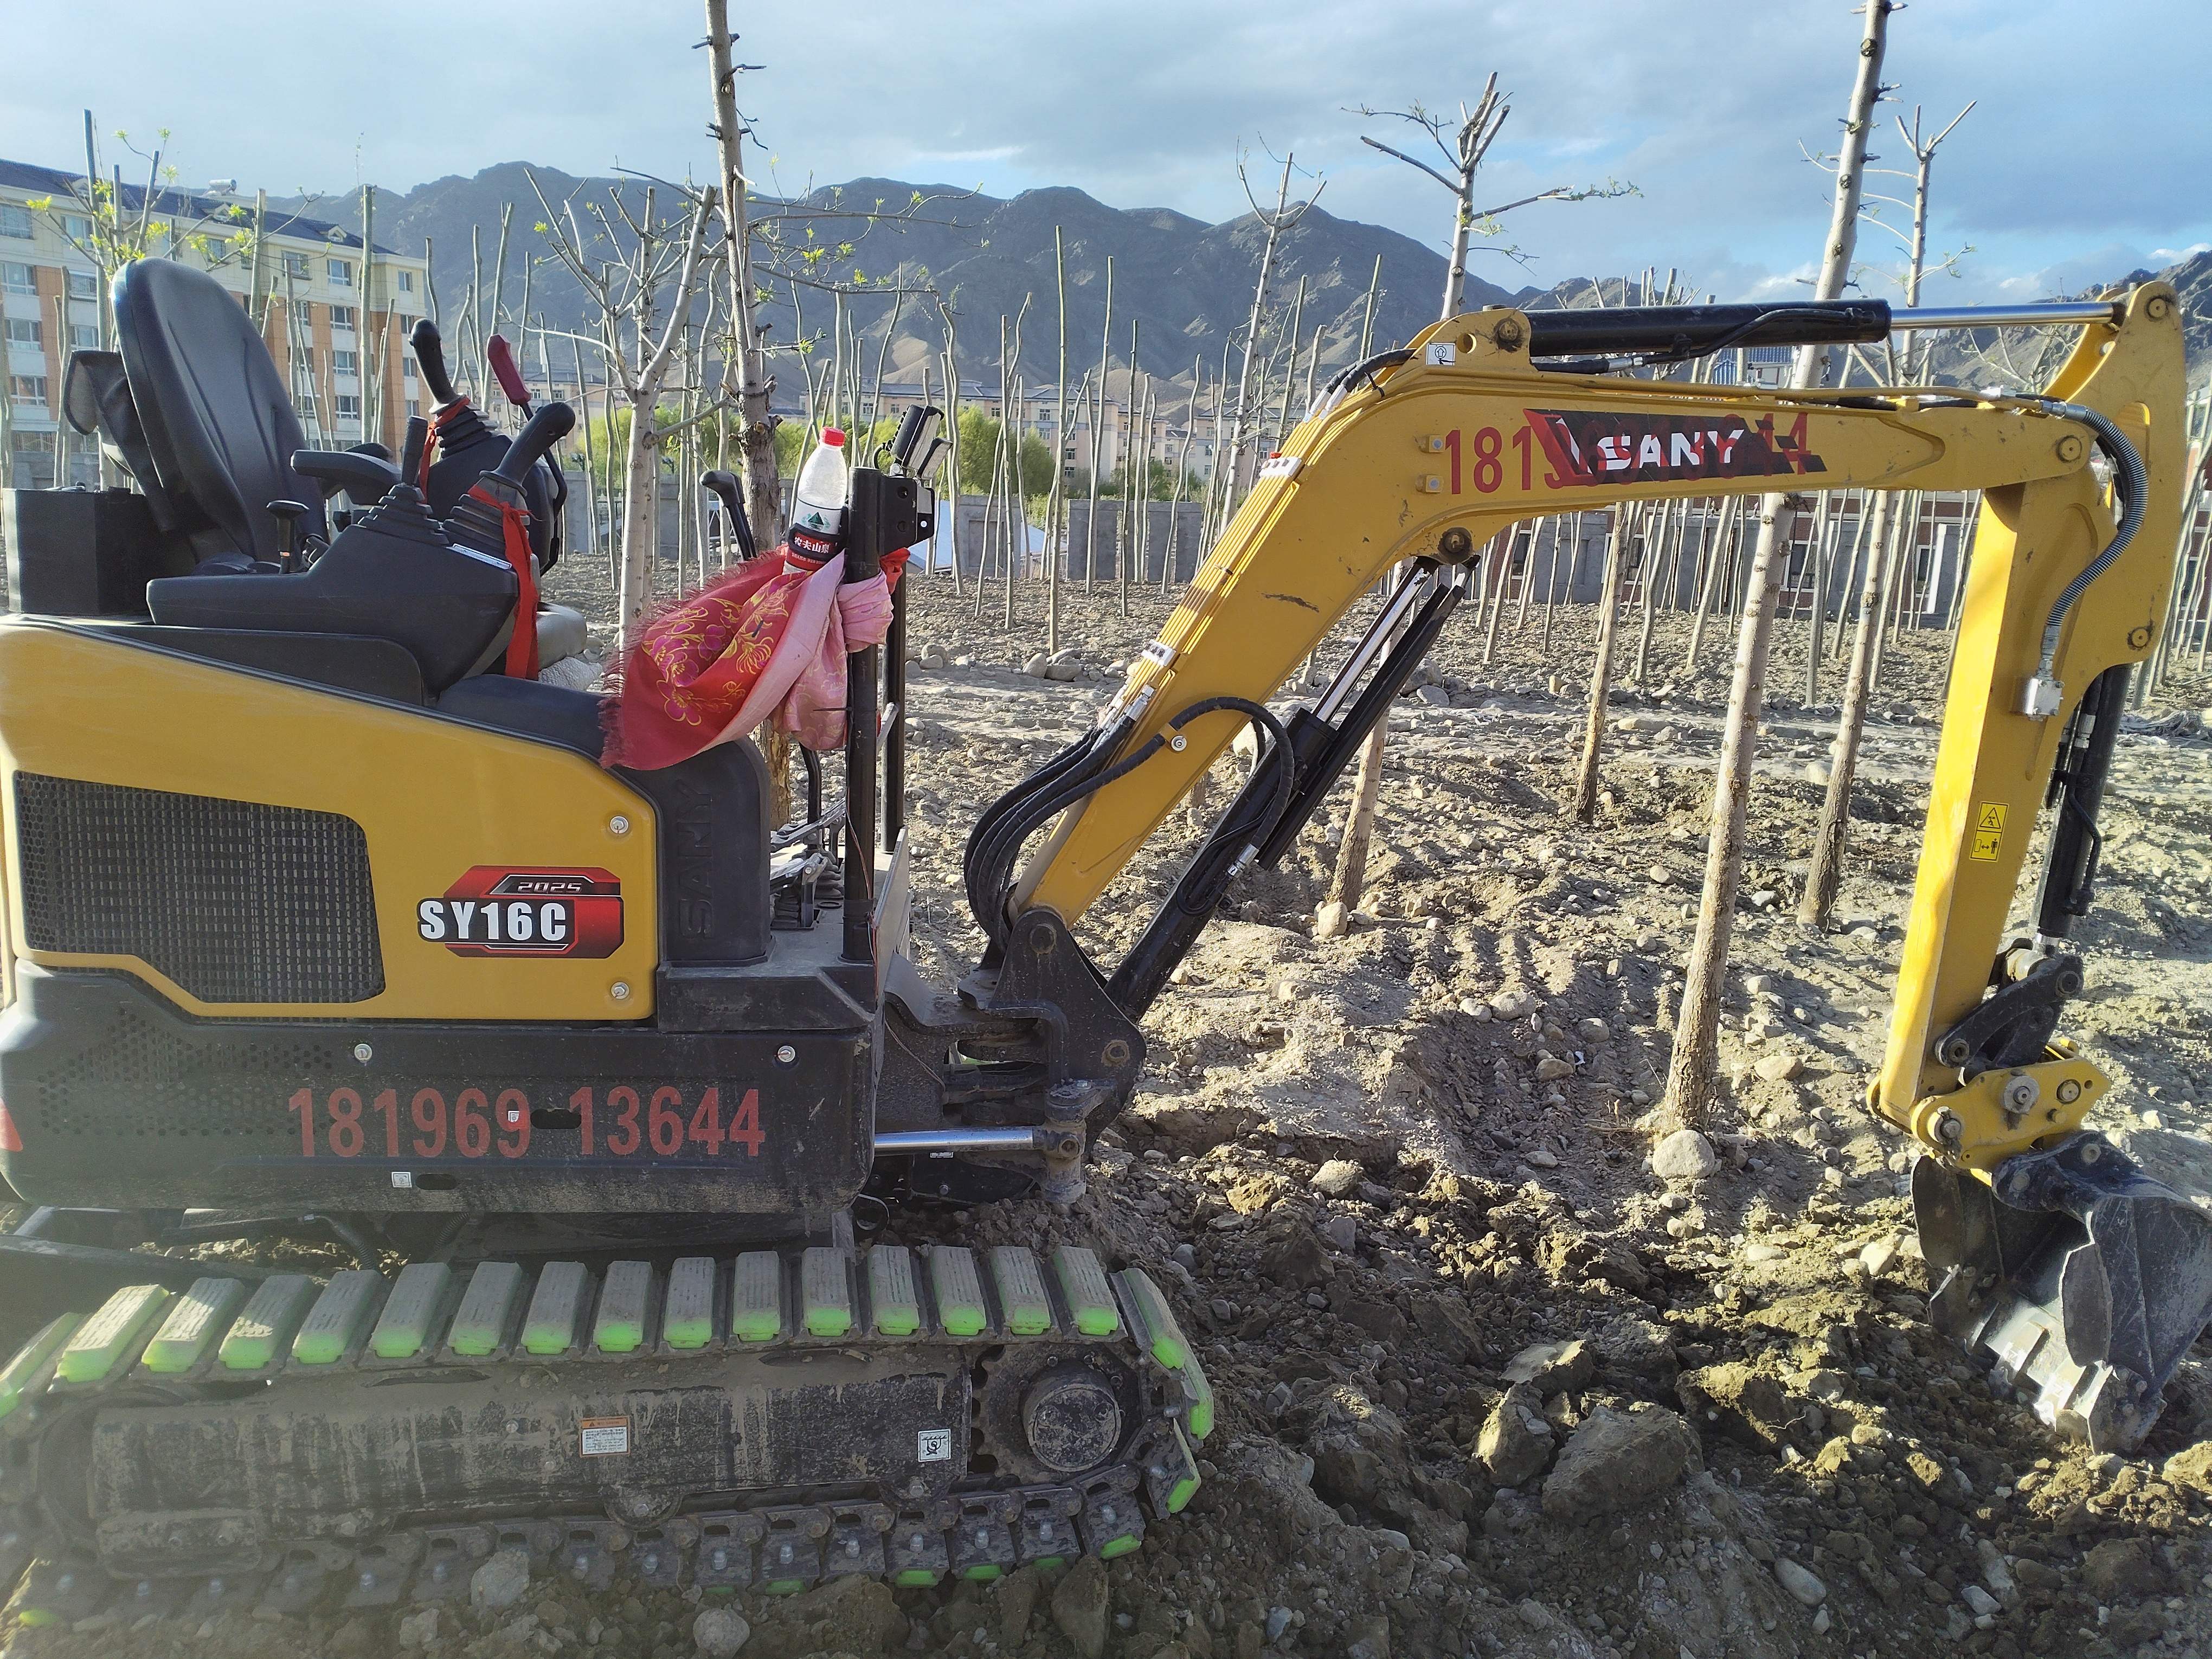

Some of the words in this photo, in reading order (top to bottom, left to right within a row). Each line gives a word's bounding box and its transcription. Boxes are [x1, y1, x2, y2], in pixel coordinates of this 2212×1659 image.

[1597, 429, 1744, 471] SANY
[795, 537, 829, 553] 农夫山泉
[676, 779, 712, 938] SANY
[518, 882, 581, 893] 2025
[420, 901, 565, 941] SY16C
